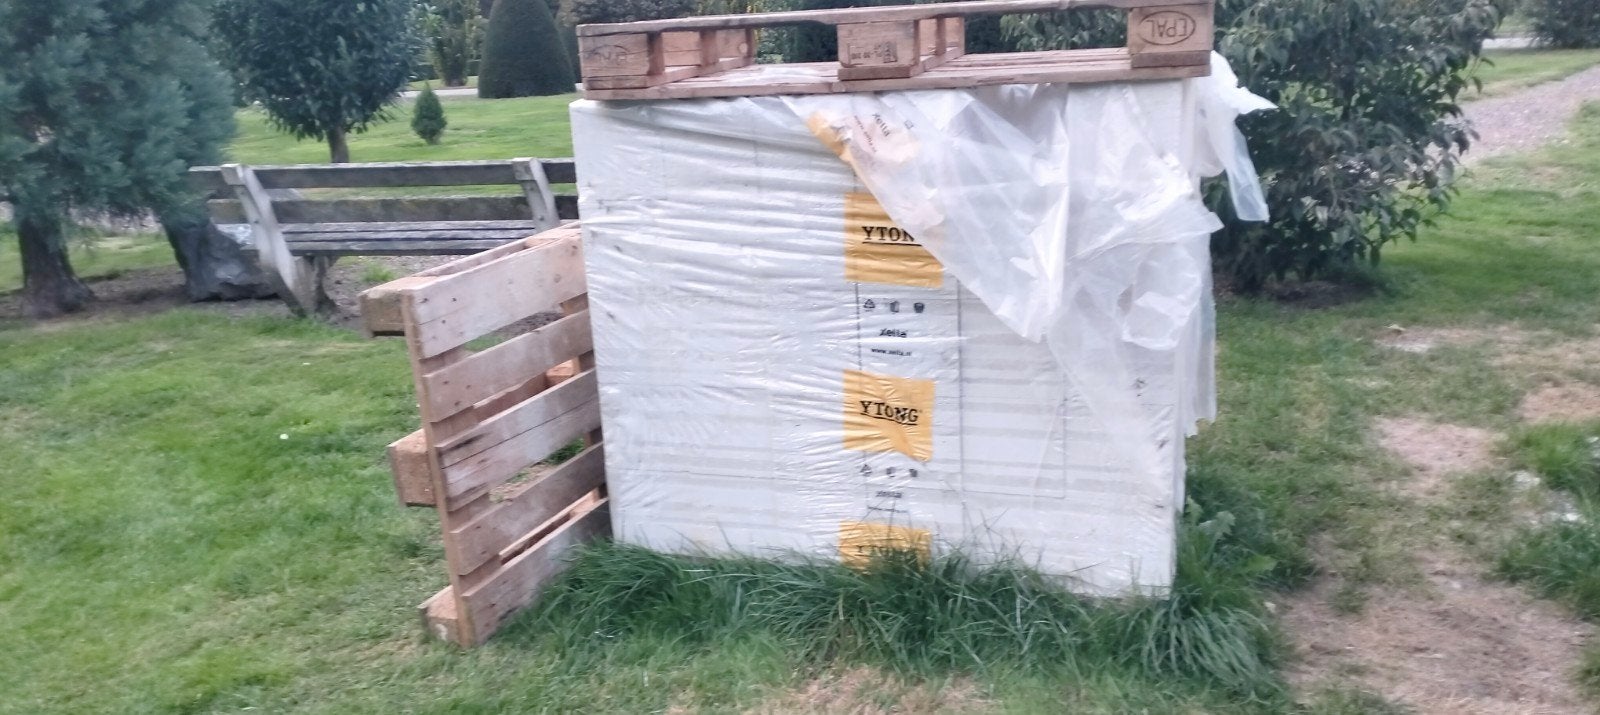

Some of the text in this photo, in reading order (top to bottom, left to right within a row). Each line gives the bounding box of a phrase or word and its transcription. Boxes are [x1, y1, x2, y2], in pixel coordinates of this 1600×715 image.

[1146, 18, 1188, 38] EPAL
[861, 226, 916, 243] YTON
[860, 400, 919, 423] YTONG
